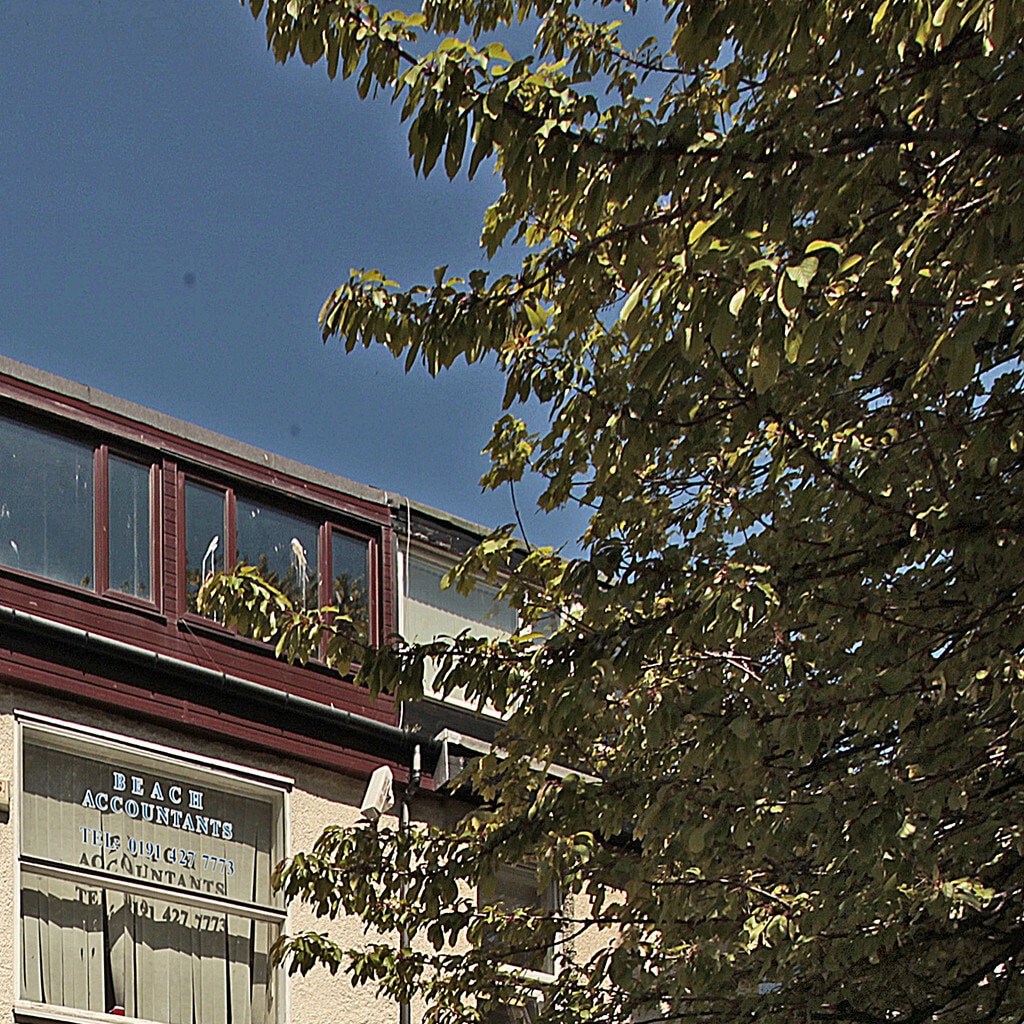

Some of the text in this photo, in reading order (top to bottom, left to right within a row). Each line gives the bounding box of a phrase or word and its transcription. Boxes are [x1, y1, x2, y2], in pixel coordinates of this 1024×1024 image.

[82, 789, 233, 840] ACCOUNTANTS
[113, 771, 204, 810] BEACH
[80, 827, 235, 876] TEL: 0191 427 7773
